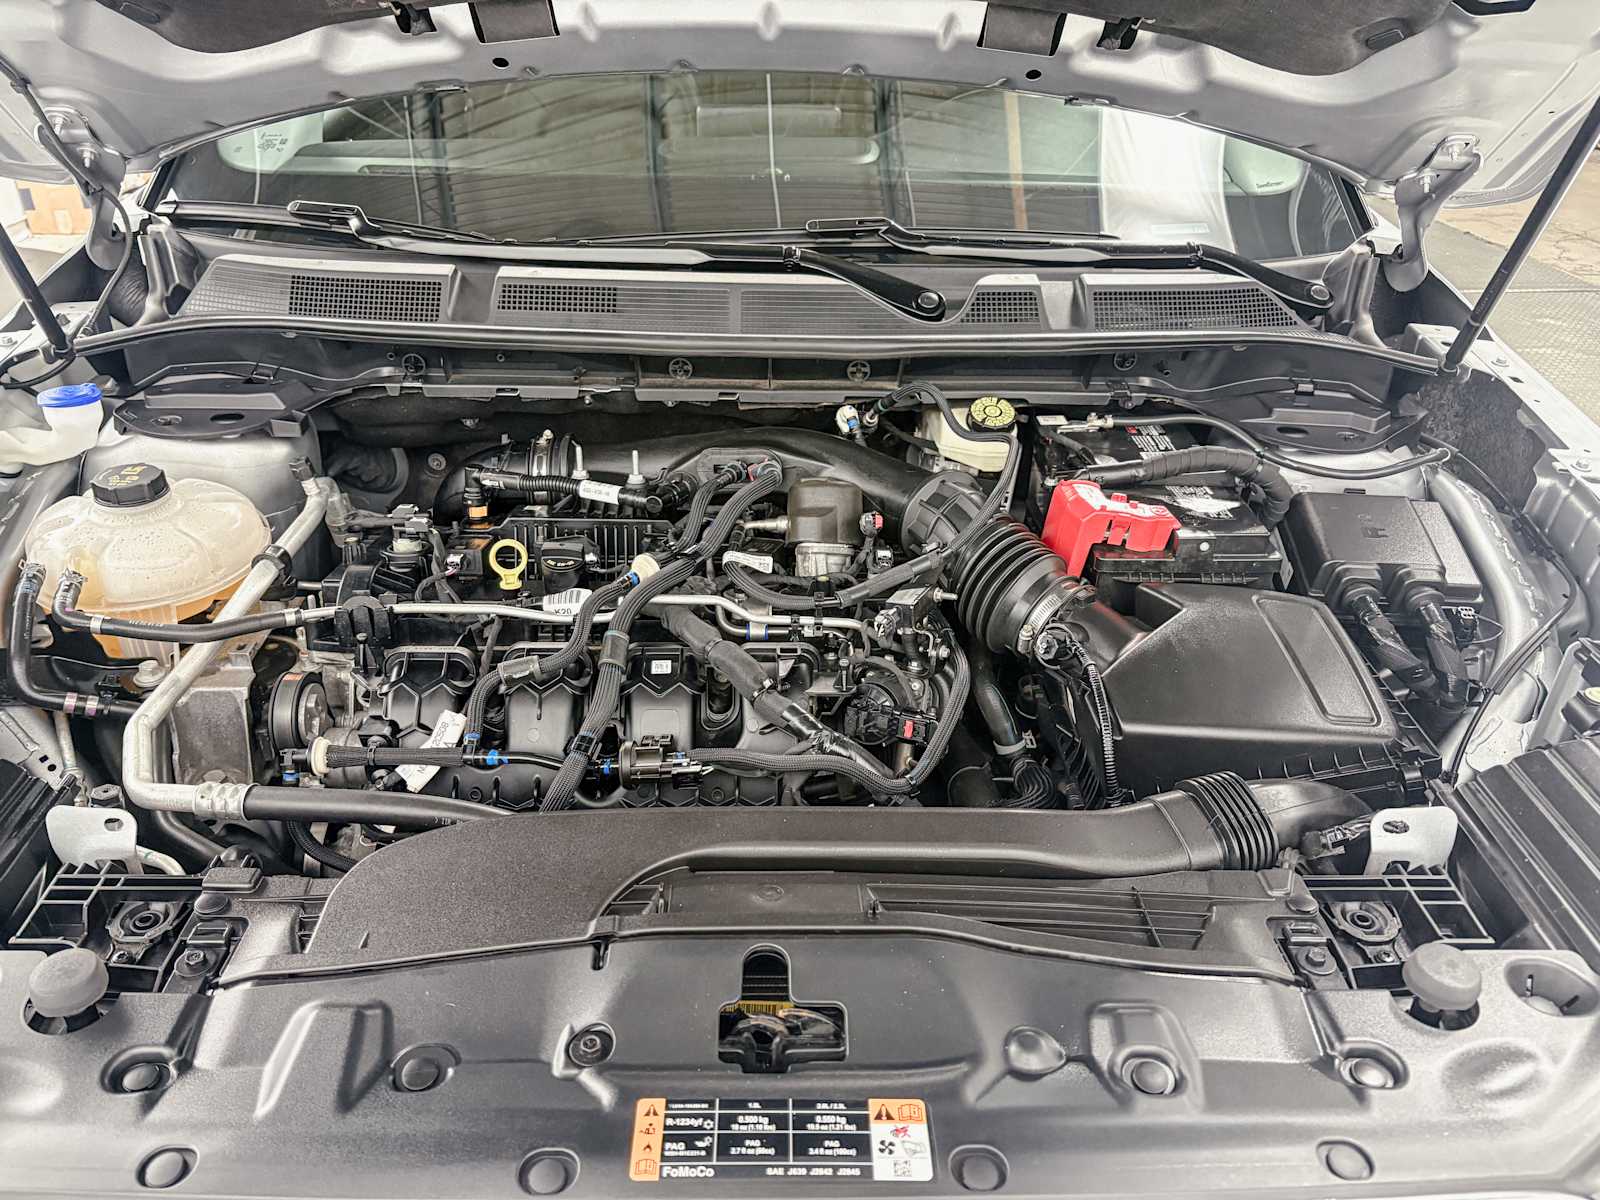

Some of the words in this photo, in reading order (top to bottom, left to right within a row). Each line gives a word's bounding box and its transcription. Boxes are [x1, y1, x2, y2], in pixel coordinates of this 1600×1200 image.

[665, 1118, 703, 1127] R-1234yf
[759, 1115, 769, 1125] kg
[836, 1115, 846, 1125] kg
[664, 1142, 686, 1151] PAG
[662, 1166, 715, 1177] FoMoCo
[766, 1167, 785, 1176] SAE
